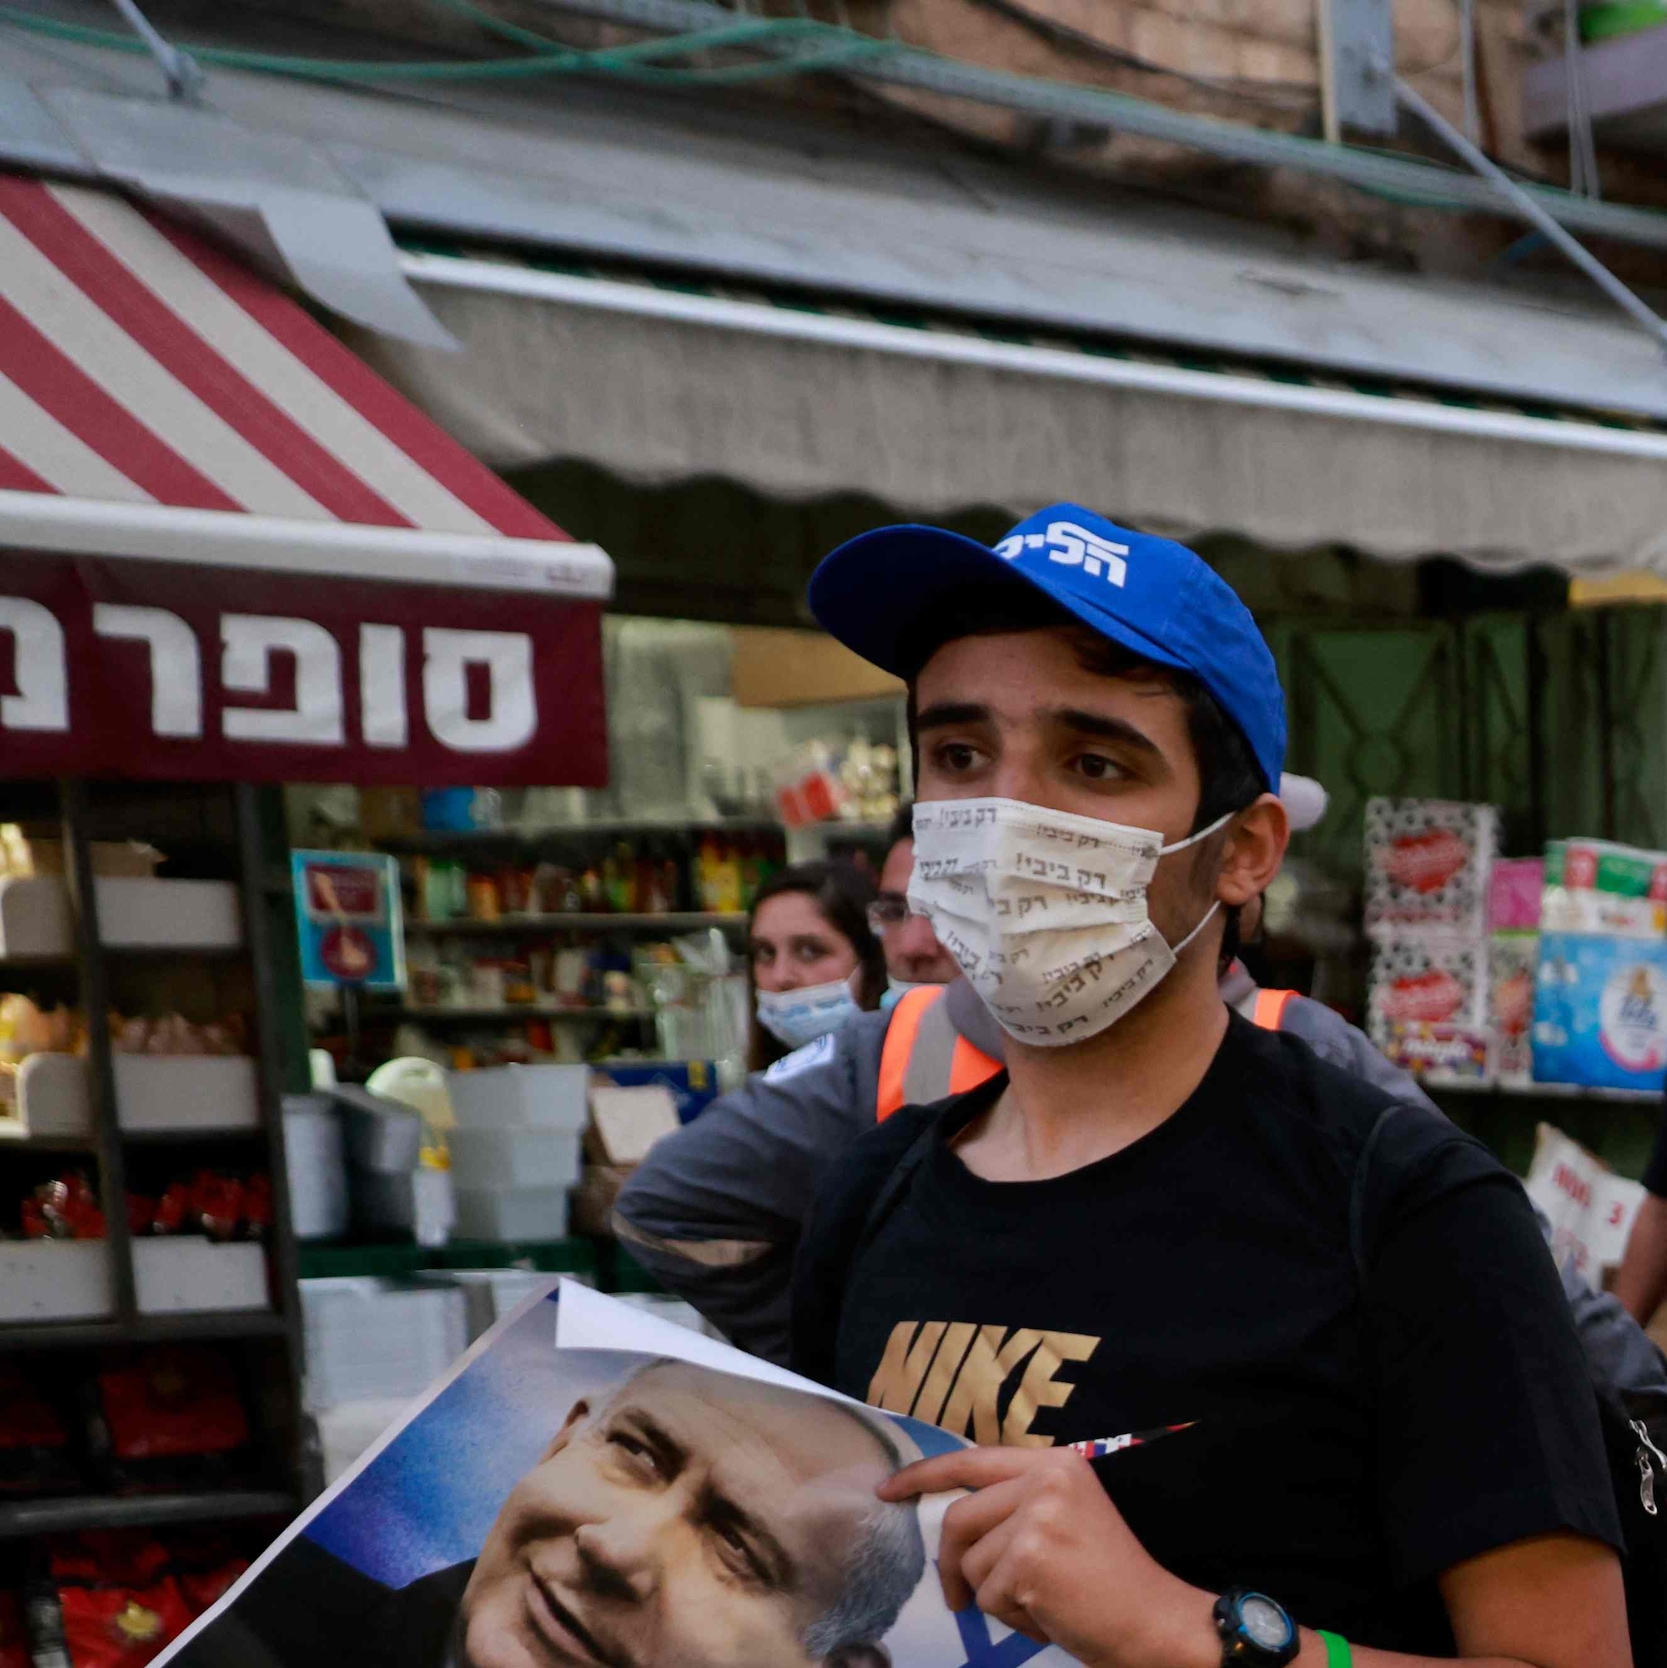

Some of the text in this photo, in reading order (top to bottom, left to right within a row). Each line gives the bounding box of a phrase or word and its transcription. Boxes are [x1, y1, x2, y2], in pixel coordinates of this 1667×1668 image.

[1016, 852, 1070, 881] ביבי!
[1077, 869, 1107, 890] רק
[1018, 895, 1048, 918] רק
[866, 1320, 1101, 1448] NIKE
